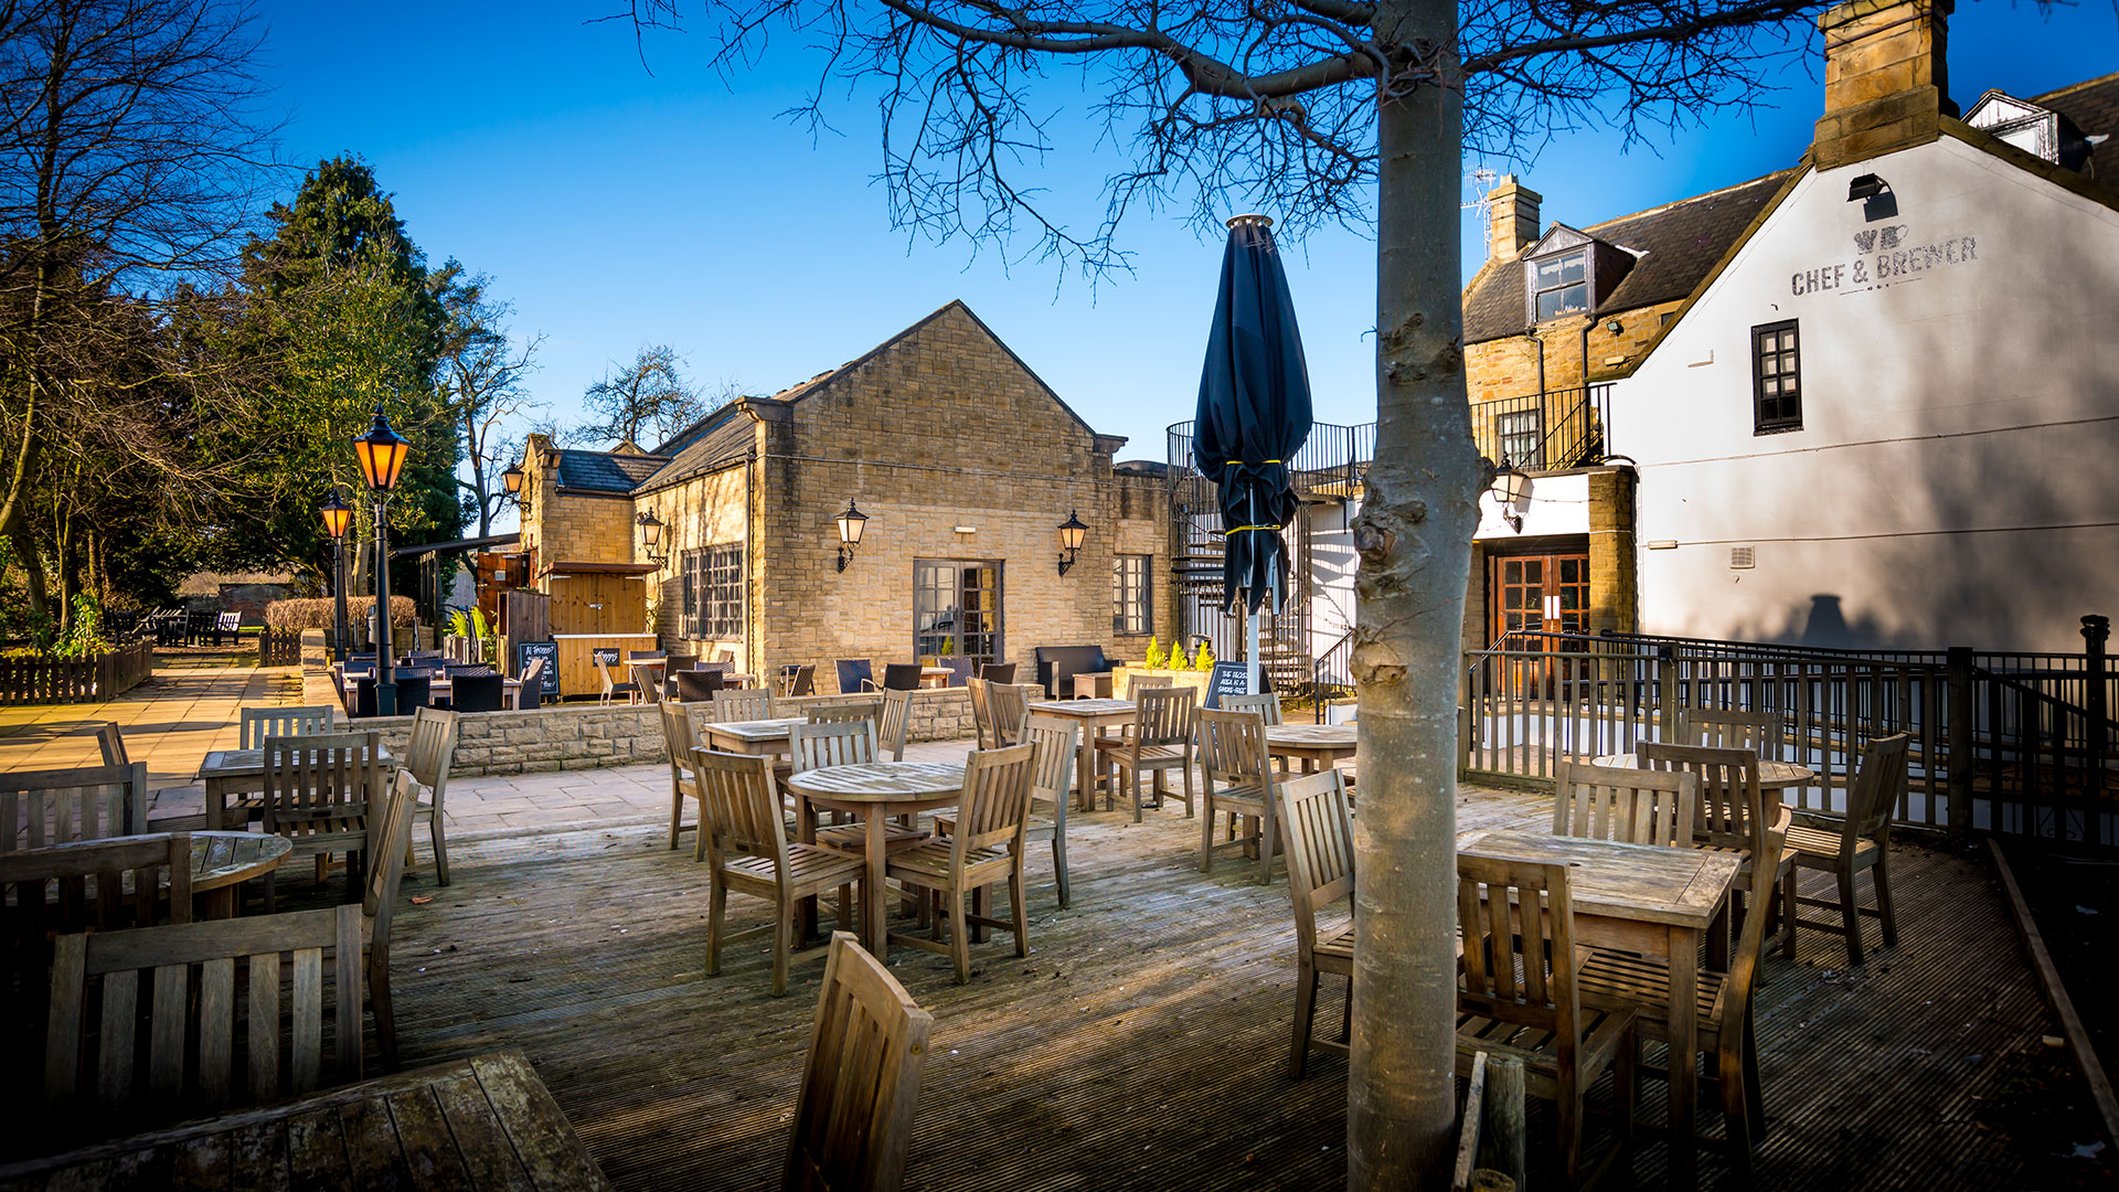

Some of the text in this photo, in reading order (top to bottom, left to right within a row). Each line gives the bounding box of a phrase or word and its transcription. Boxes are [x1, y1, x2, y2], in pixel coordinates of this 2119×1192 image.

[1791, 236, 1977, 296] CHEF & BREWER
